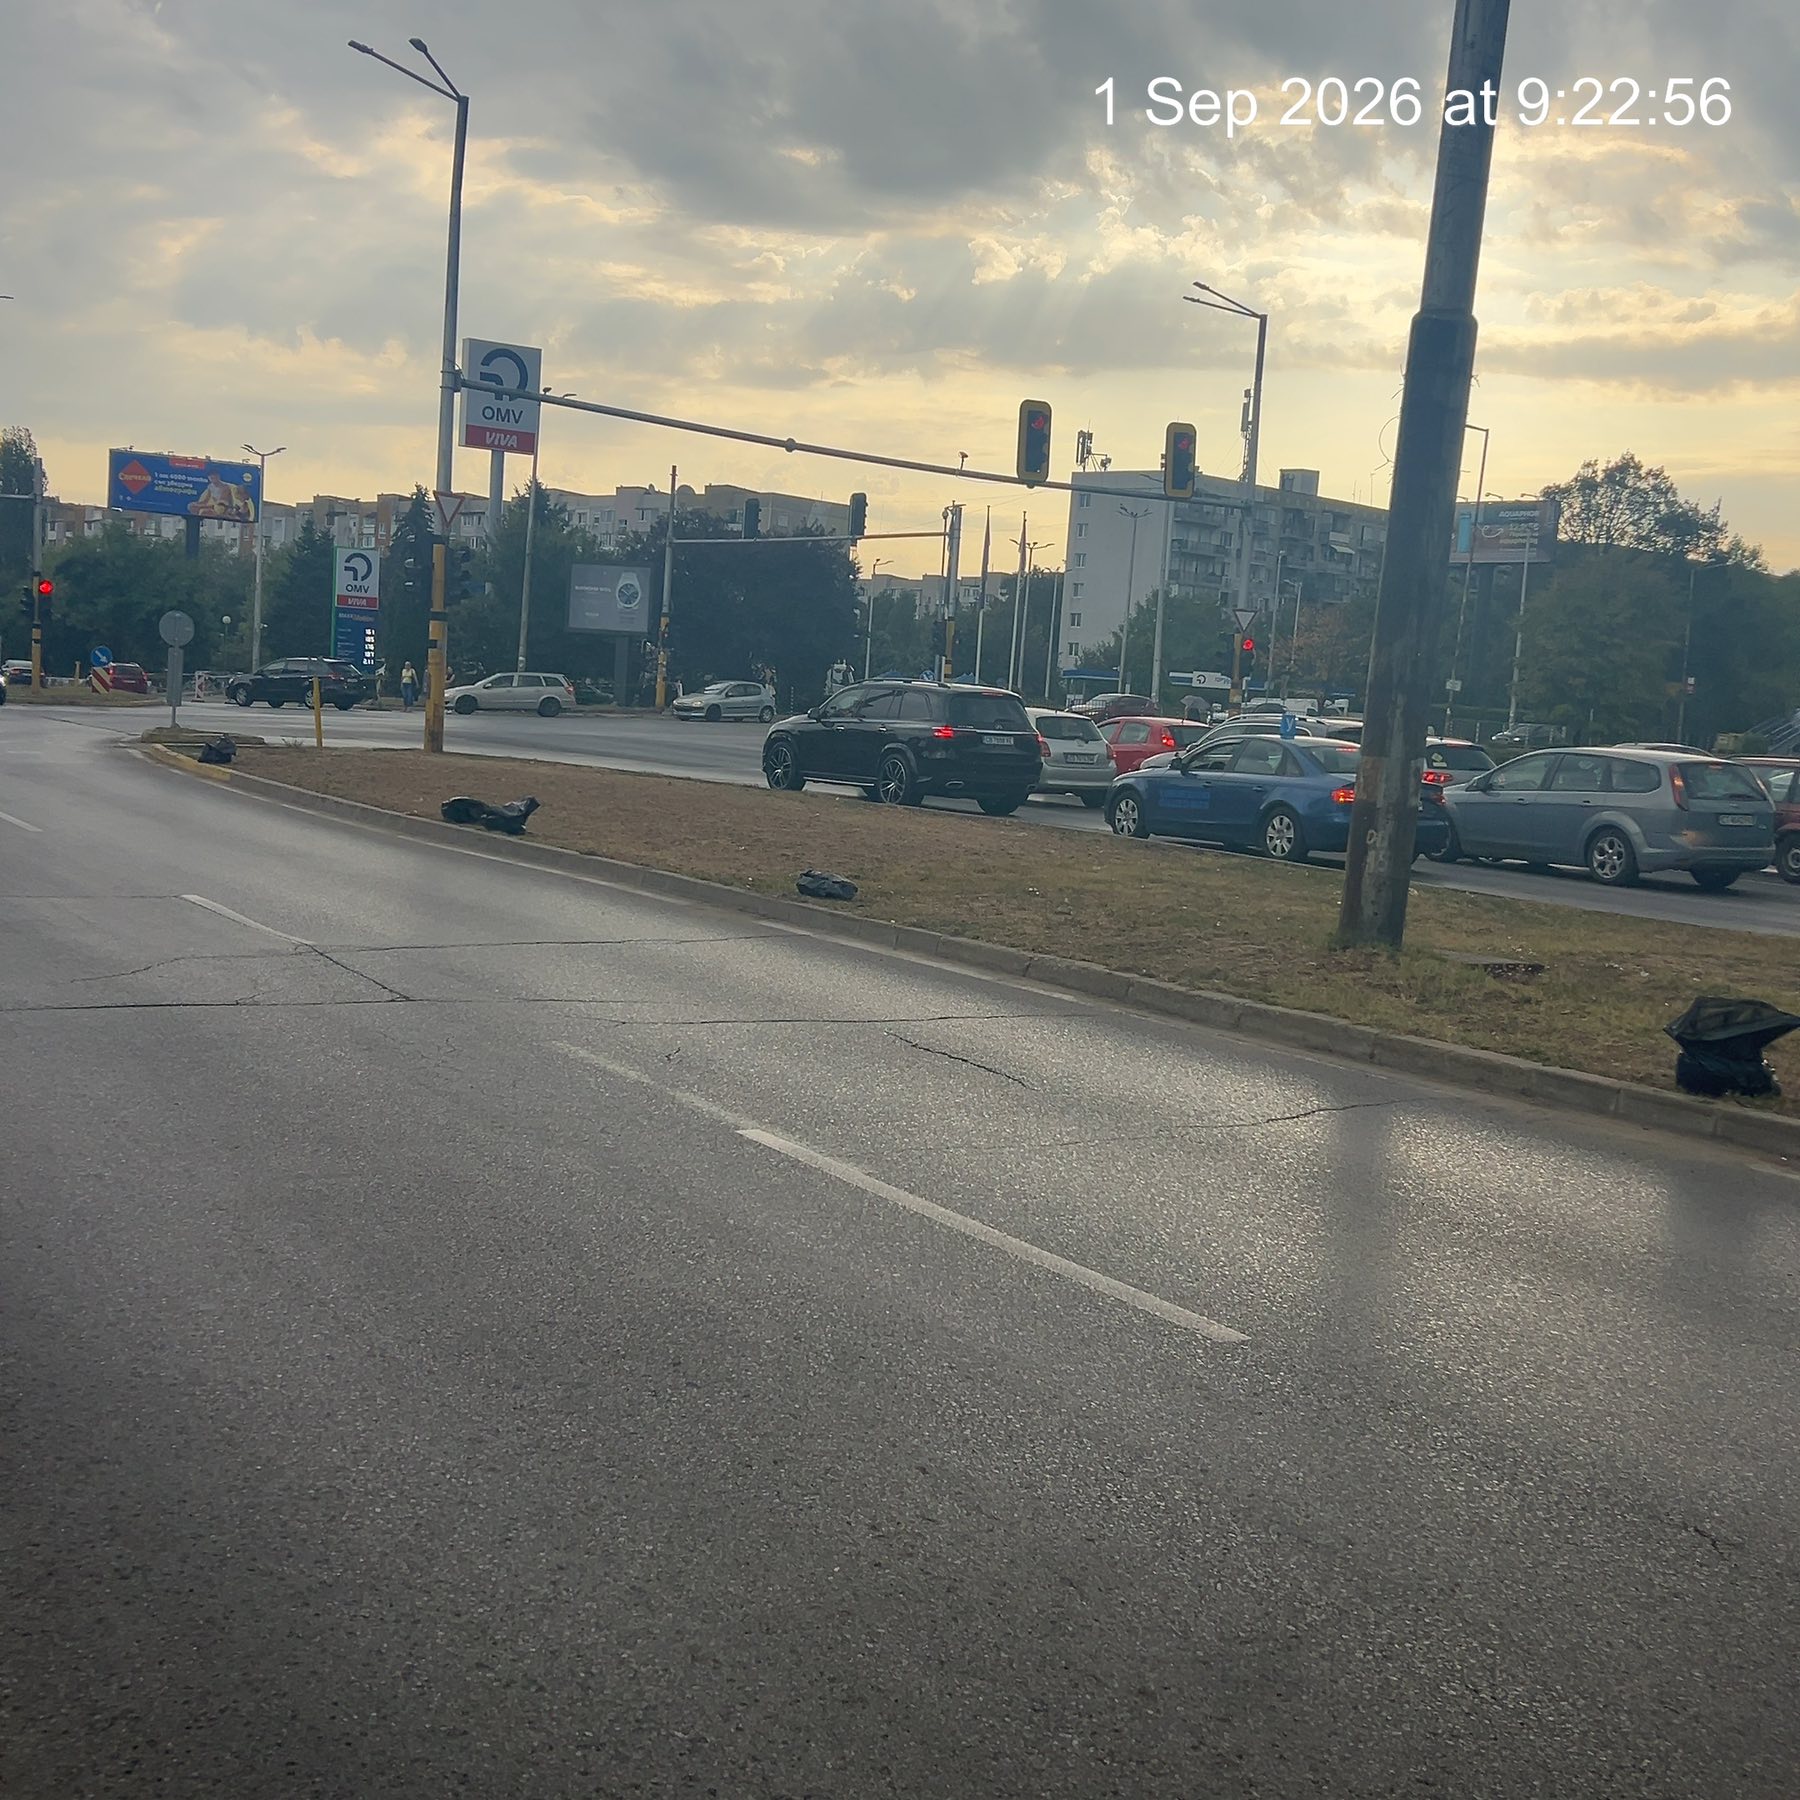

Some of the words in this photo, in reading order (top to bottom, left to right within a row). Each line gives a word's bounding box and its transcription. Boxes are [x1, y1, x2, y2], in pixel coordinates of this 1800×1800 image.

[482, 406, 523, 424] OMV
[486, 432, 517, 448] VIVA
[345, 584, 370, 594] OMV
[347, 598, 367, 606] VIVA
